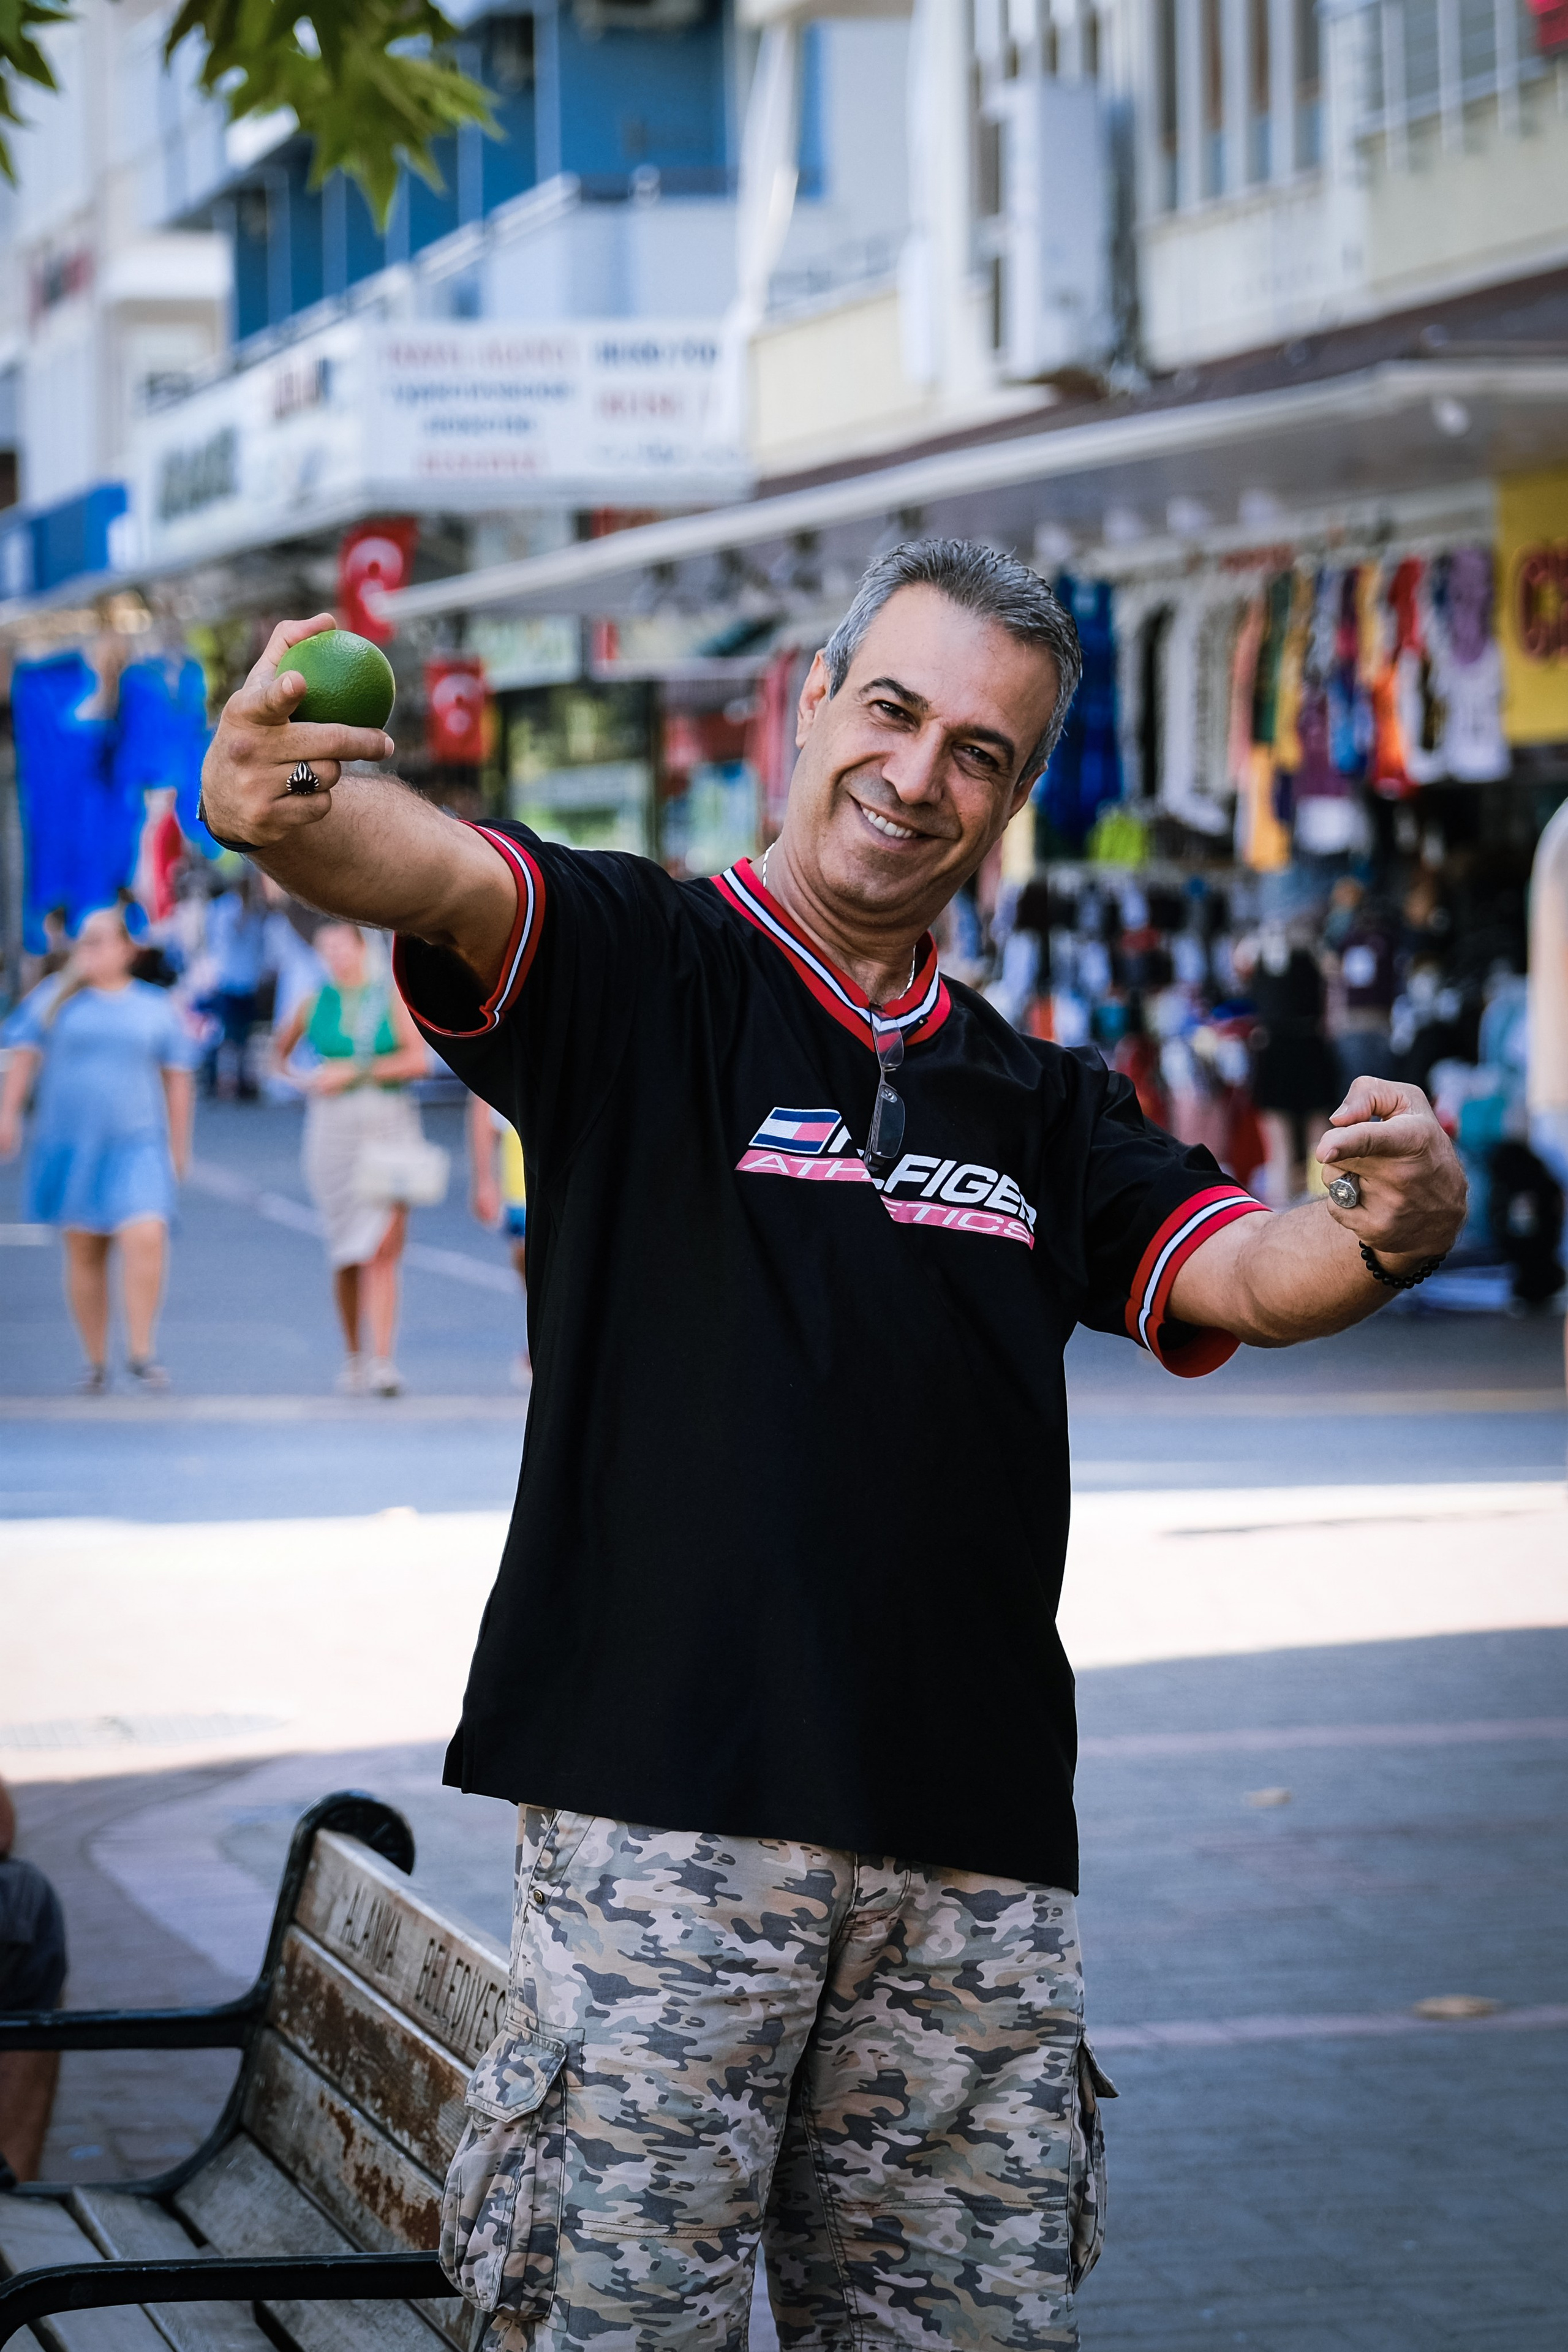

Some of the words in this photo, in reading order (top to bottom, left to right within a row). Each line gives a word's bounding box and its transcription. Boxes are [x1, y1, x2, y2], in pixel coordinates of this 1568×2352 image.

[742, 1154, 1030, 1243] ATHTICS
[827, 1125, 1036, 1234] FIGER
[339, 1882, 403, 1977] ALANYA
[415, 1937, 507, 2052] BELEDİYES
